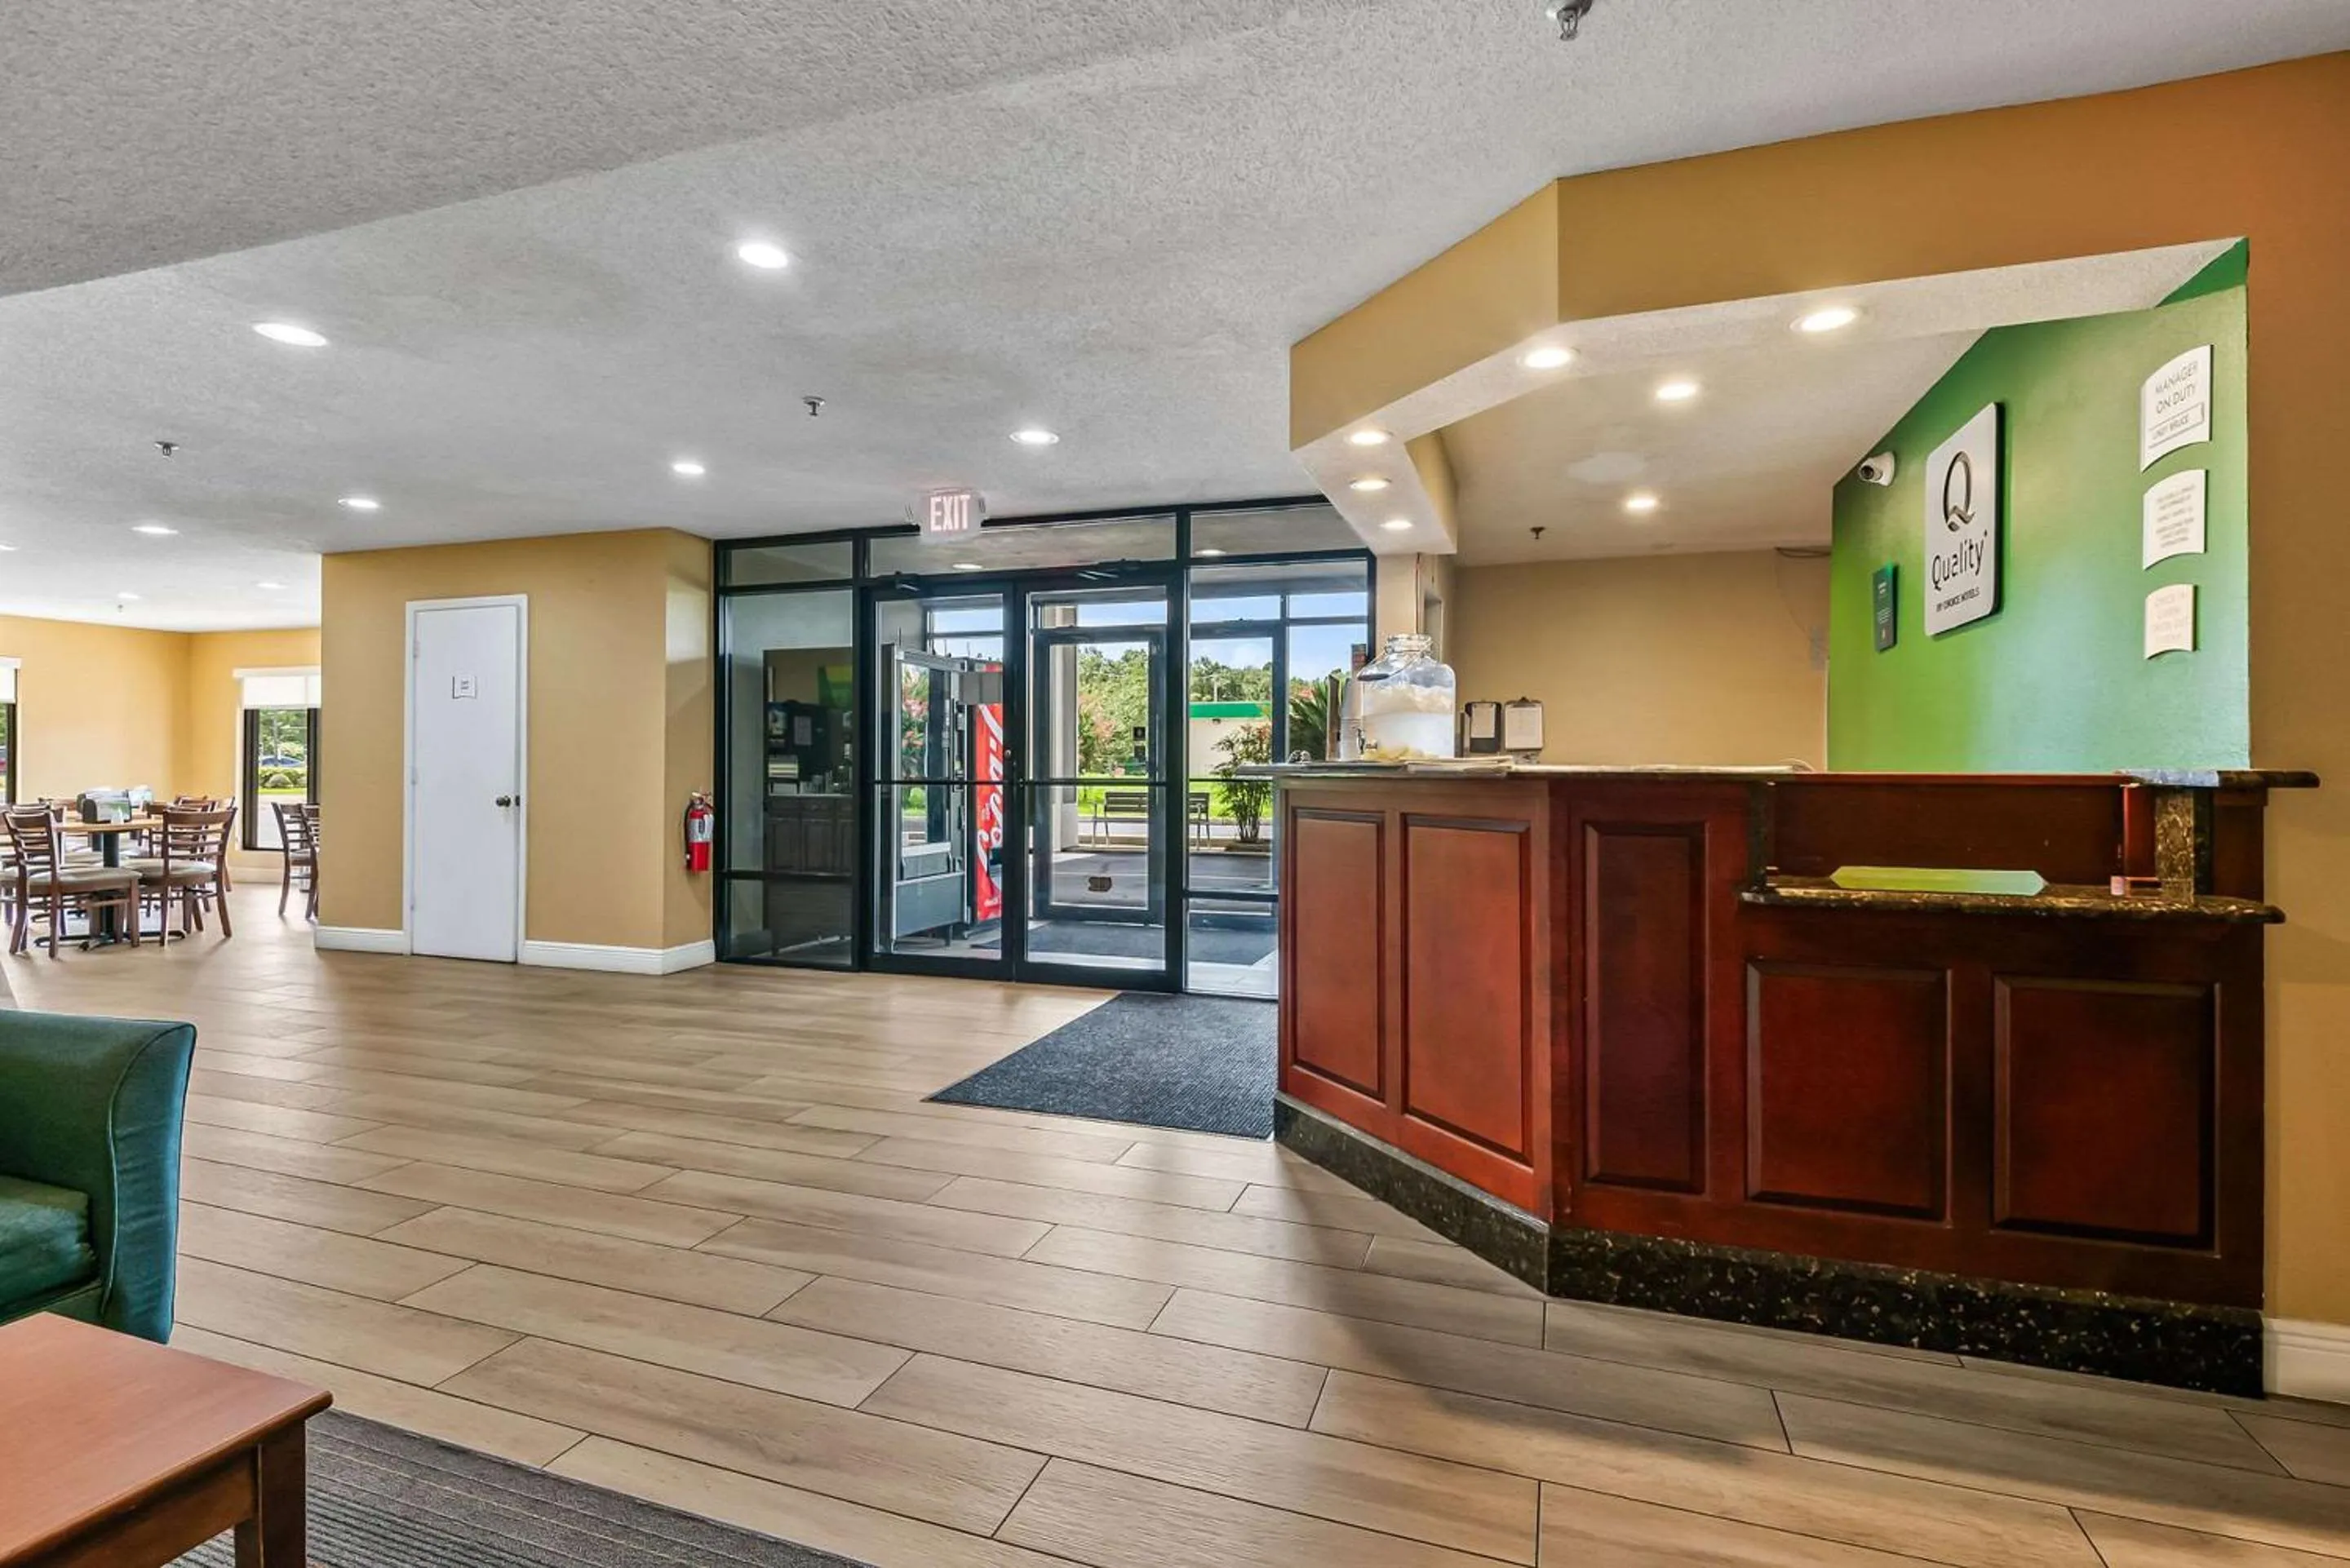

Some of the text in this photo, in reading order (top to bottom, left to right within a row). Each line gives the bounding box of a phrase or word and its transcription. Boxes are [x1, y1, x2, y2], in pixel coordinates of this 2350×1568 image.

[2155, 361, 2198, 393] MANAGER
[2156, 383, 2195, 414] ON DUTY
[930, 494, 970, 532] EXIT
[1931, 538, 1984, 591] Quality
